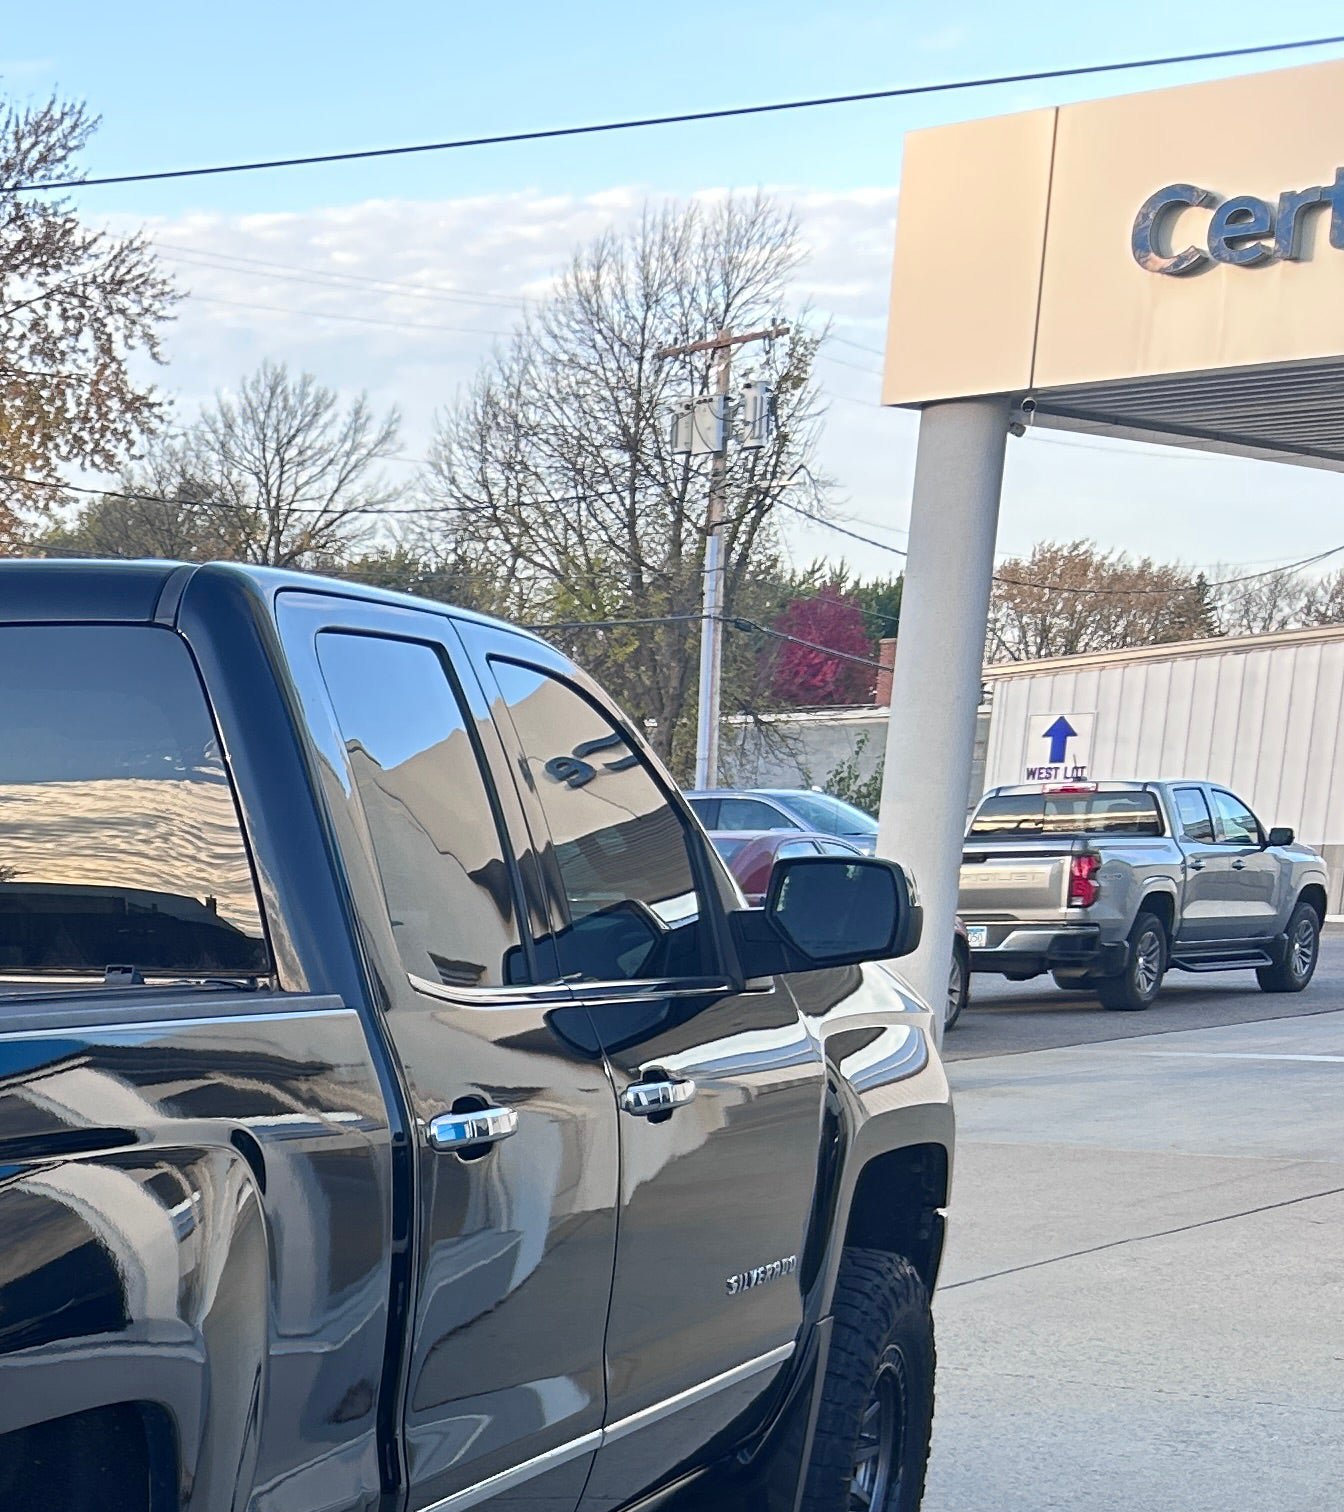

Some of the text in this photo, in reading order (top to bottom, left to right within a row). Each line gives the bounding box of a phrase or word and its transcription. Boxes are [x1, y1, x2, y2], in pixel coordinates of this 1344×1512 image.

[1026, 765, 1087, 780] WEST LOT
[725, 1255, 797, 1296] SILVERADO
